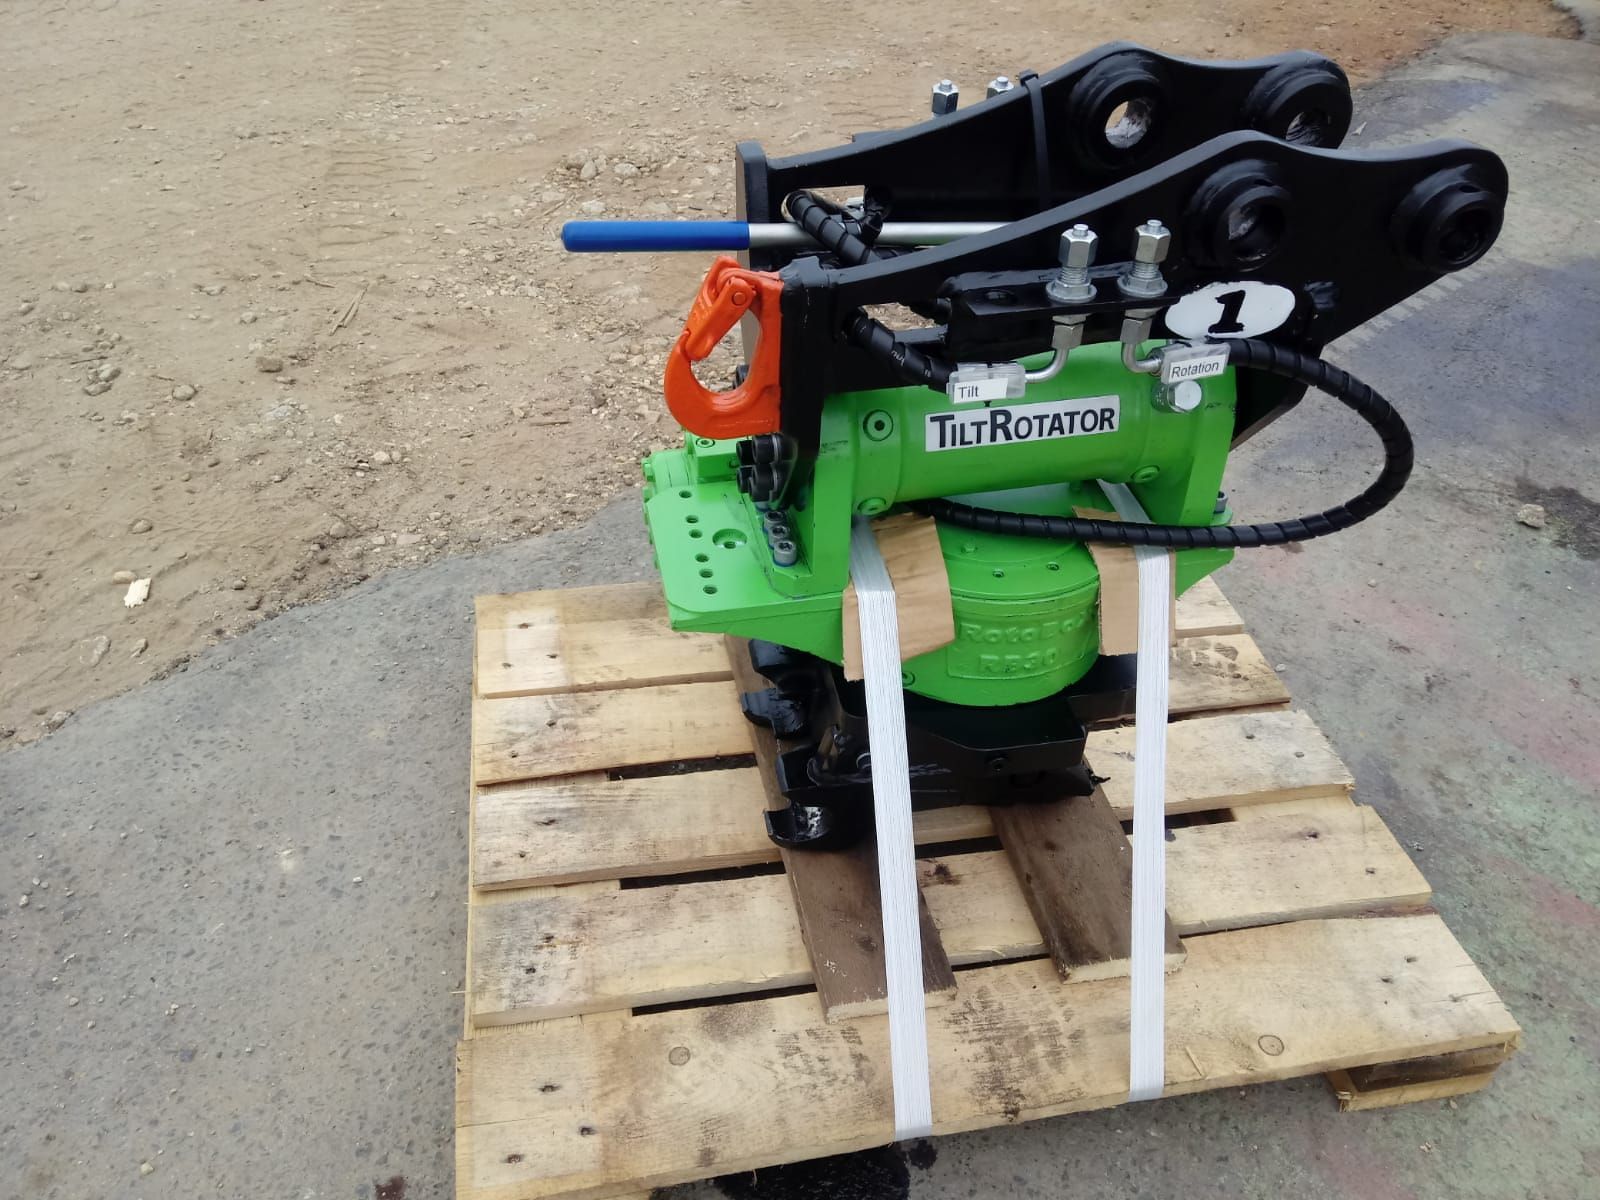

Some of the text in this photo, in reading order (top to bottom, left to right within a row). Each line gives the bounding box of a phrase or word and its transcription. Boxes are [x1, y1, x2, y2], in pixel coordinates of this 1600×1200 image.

[1208, 289, 1246, 334] 1
[1170, 360, 1220, 379] Rotation
[957, 384, 980, 399] Tilt
